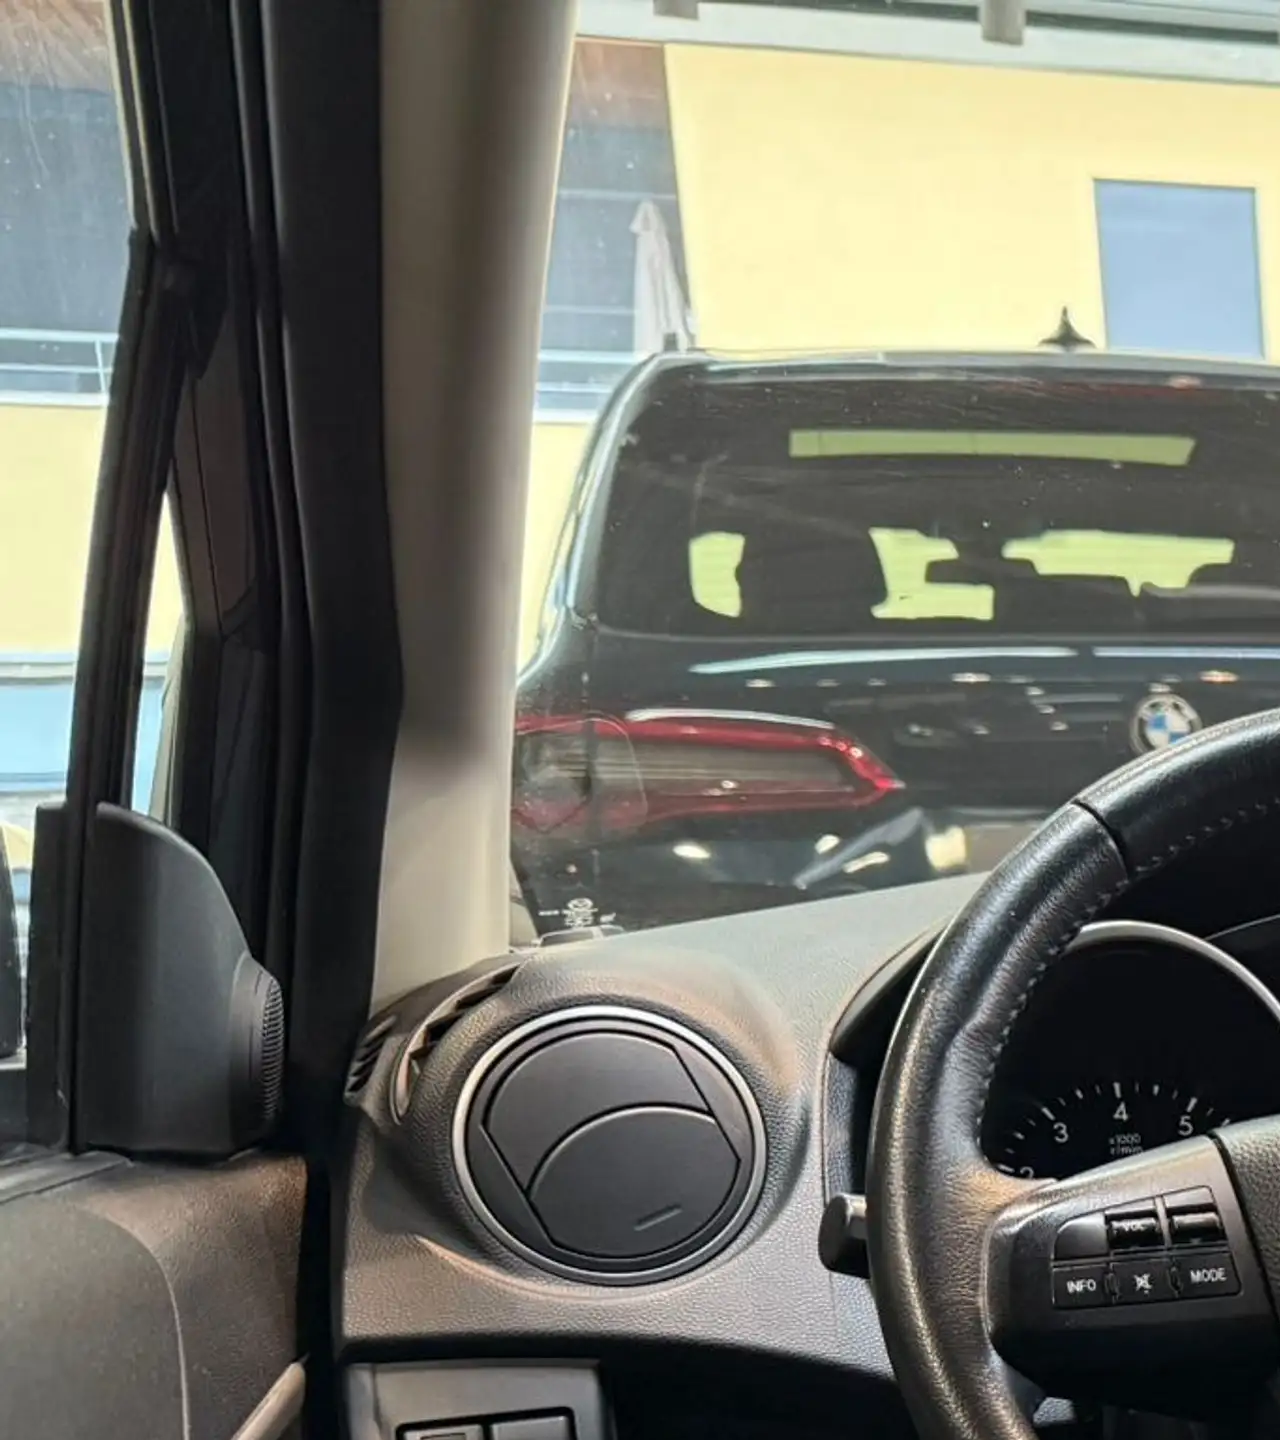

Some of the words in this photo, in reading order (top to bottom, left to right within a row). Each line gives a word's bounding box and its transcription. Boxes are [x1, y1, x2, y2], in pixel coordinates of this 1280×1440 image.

[1113, 1101, 1129, 1122] 4
[1052, 1121, 1069, 1143] 3
[1177, 1115, 1194, 1136] 5
[1066, 1278, 1097, 1294] INFO
[1189, 1267, 1228, 1284] MODE
